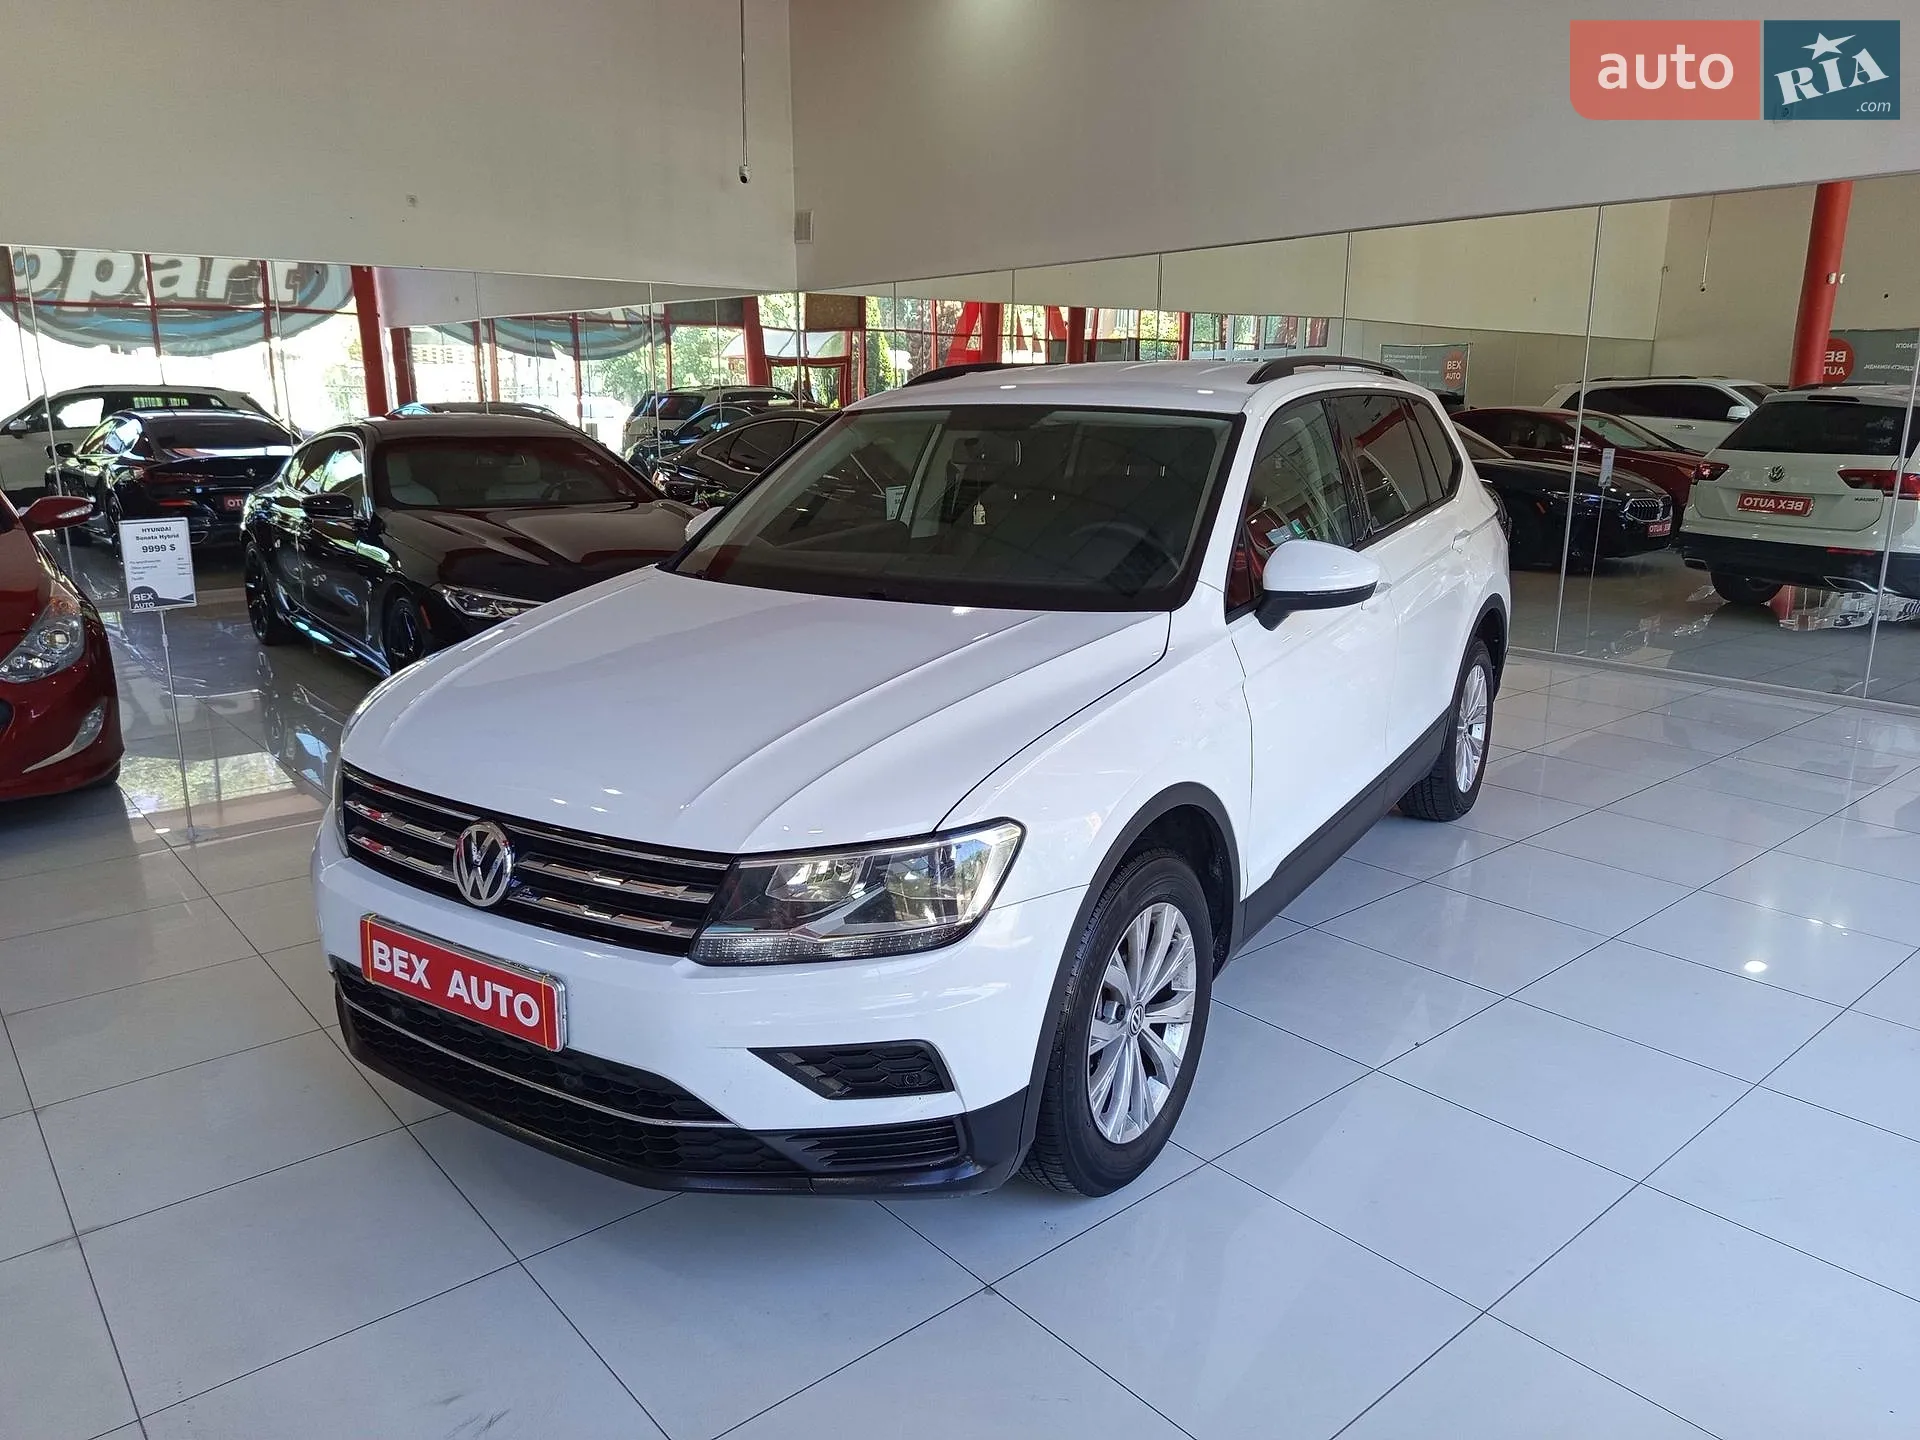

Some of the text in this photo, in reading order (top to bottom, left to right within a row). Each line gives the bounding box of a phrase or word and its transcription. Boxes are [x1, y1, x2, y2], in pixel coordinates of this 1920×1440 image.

[1446, 360, 1462, 370] BEX
[1445, 372, 1461, 380] AUTO
[142, 543, 176, 553] 9999 $
[133, 593, 154, 601] BEX
[372, 939, 541, 1027] BEX AUTO
